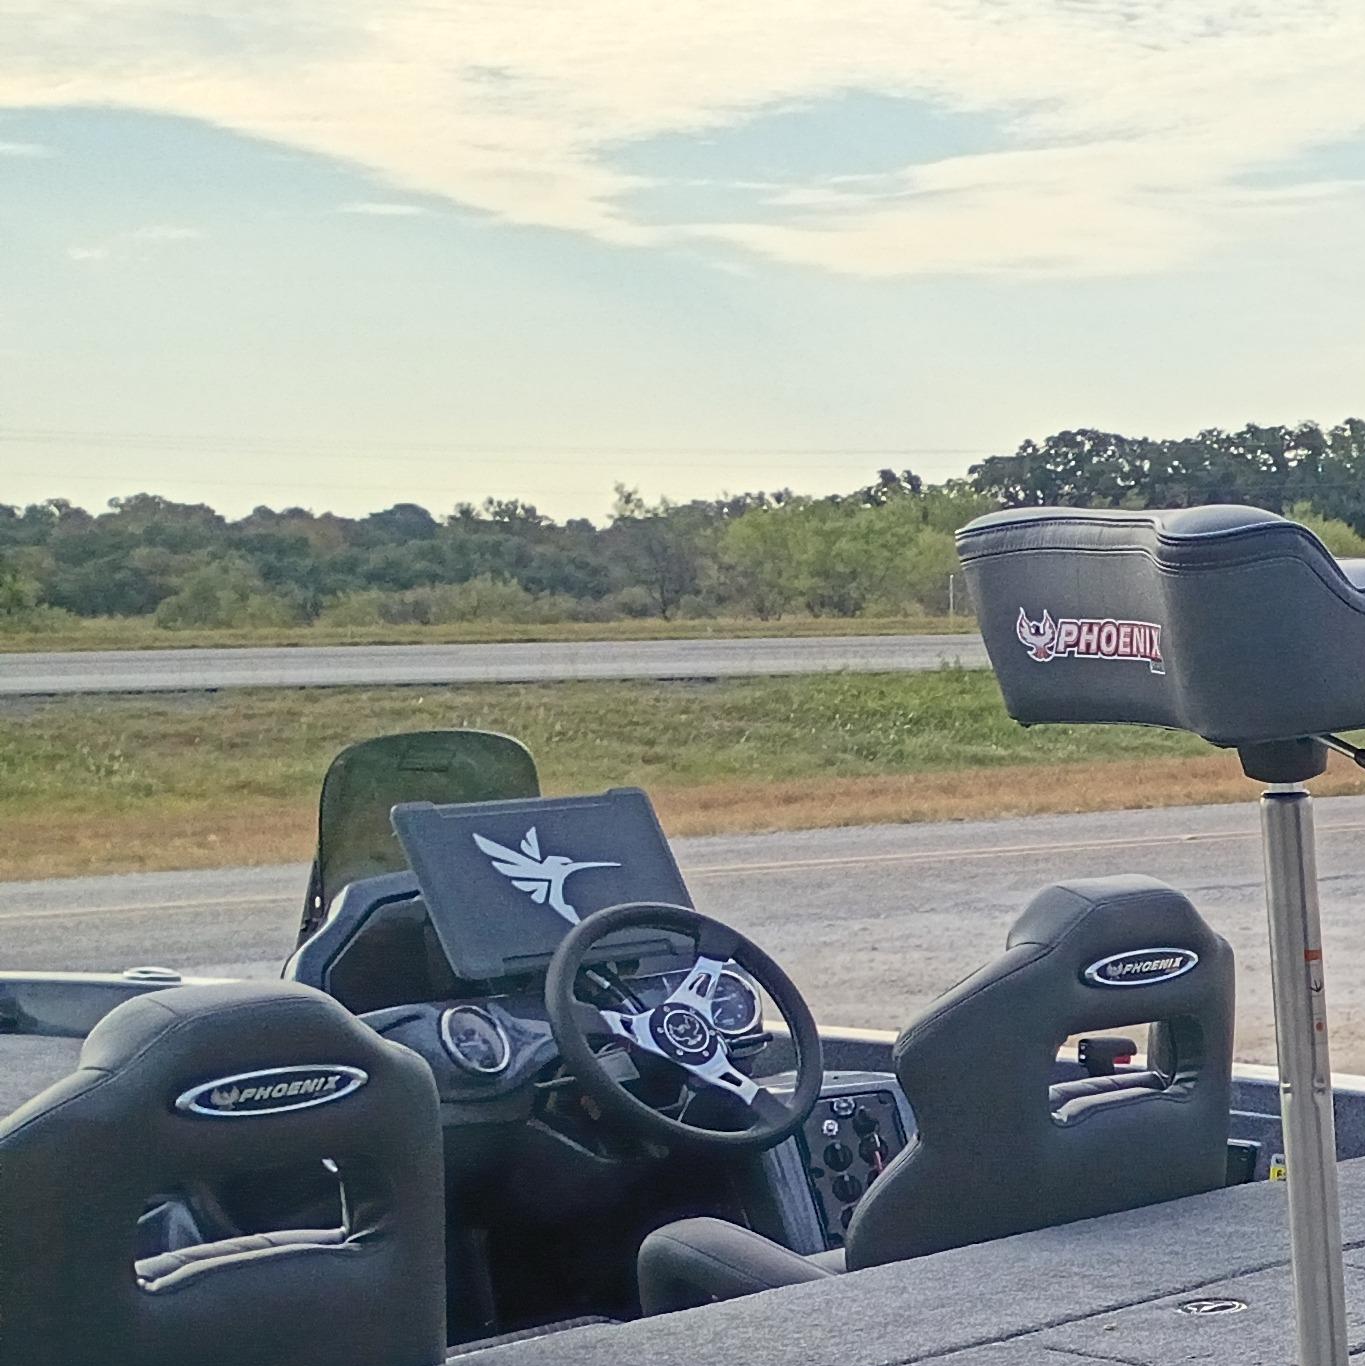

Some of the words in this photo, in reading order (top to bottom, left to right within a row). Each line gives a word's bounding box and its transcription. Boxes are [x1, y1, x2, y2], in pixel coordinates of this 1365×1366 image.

[1054, 619, 1163, 662] PHOENIX
[1121, 957, 1183, 975] PHOENIX
[238, 1075, 341, 1103] PHOENIX
